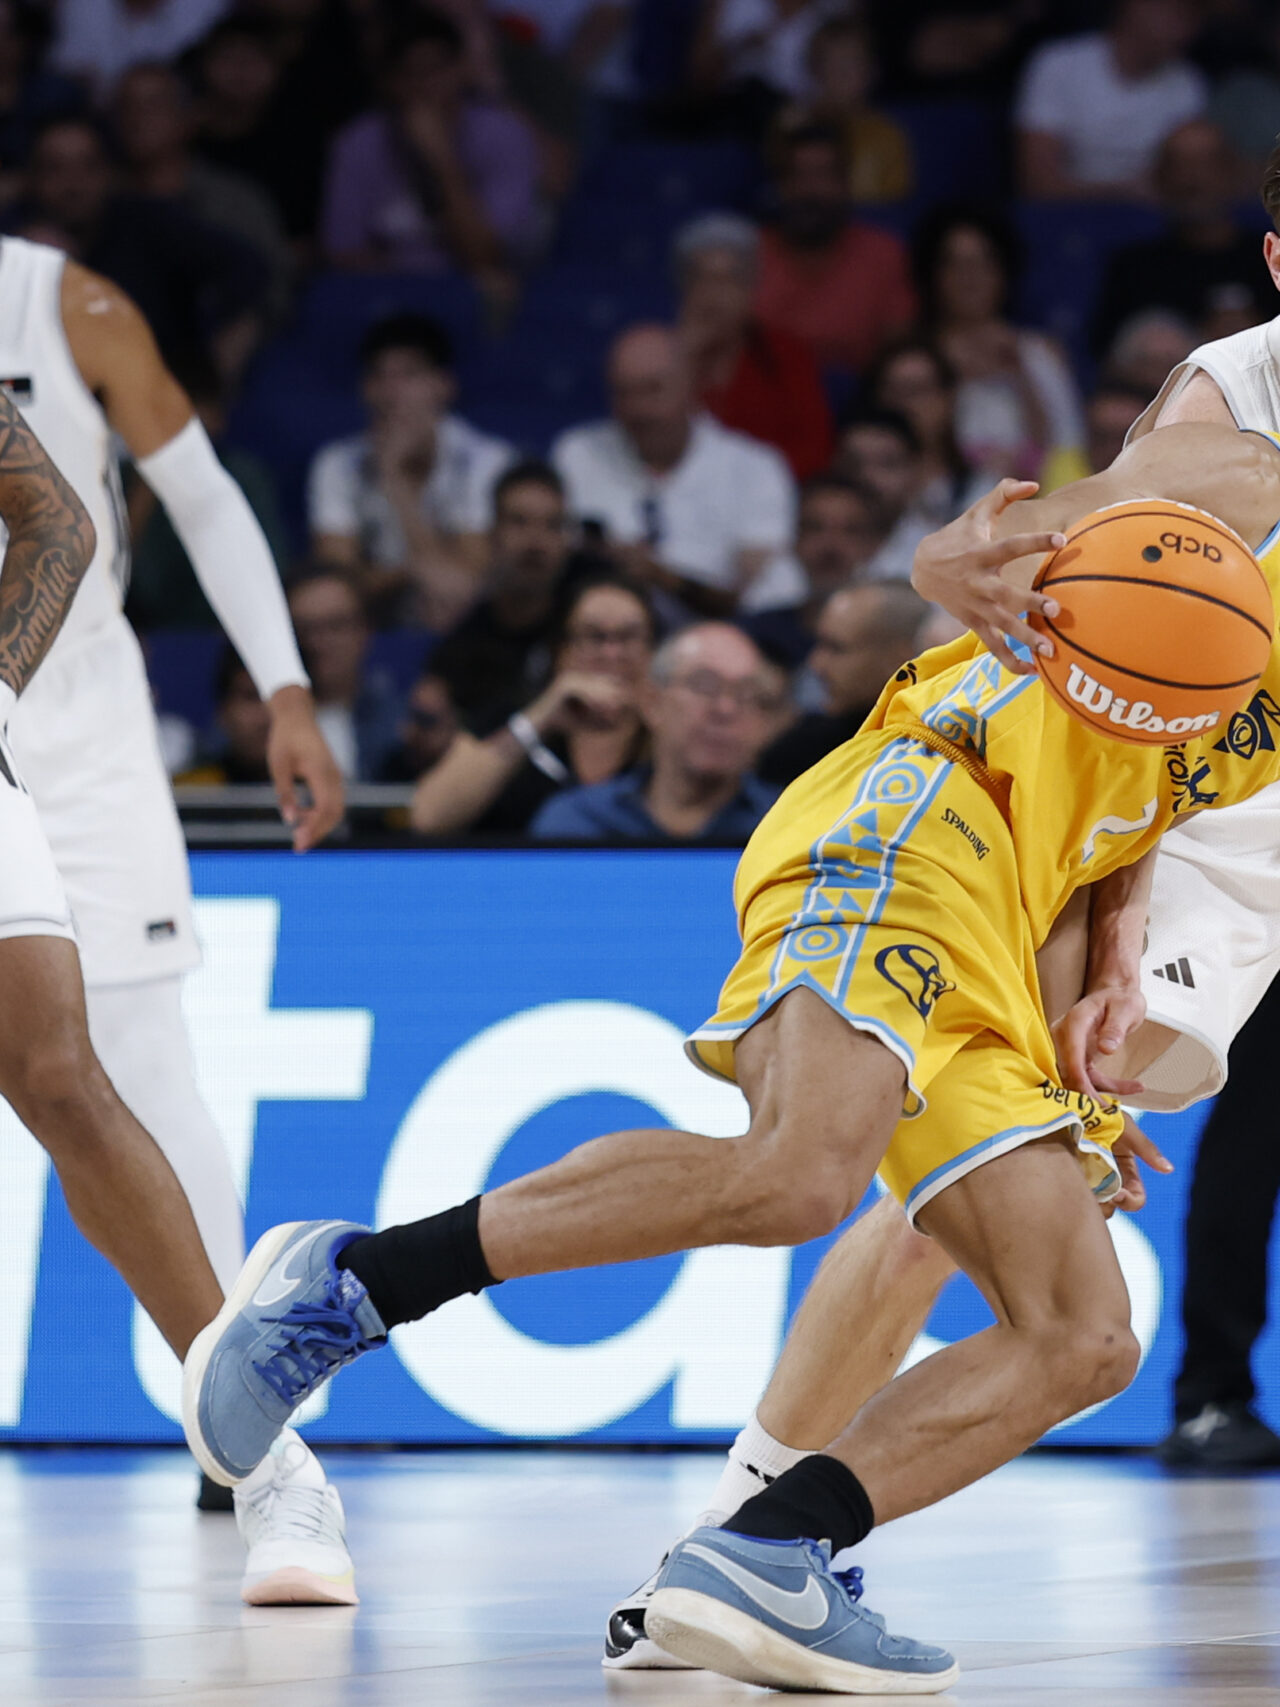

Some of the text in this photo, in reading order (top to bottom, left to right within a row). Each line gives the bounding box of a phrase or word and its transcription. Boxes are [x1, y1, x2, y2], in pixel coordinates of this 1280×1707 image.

[1159, 532, 1222, 564] acb
[1066, 663, 1221, 734] Wilson
[940, 807, 991, 861] SPALDING
